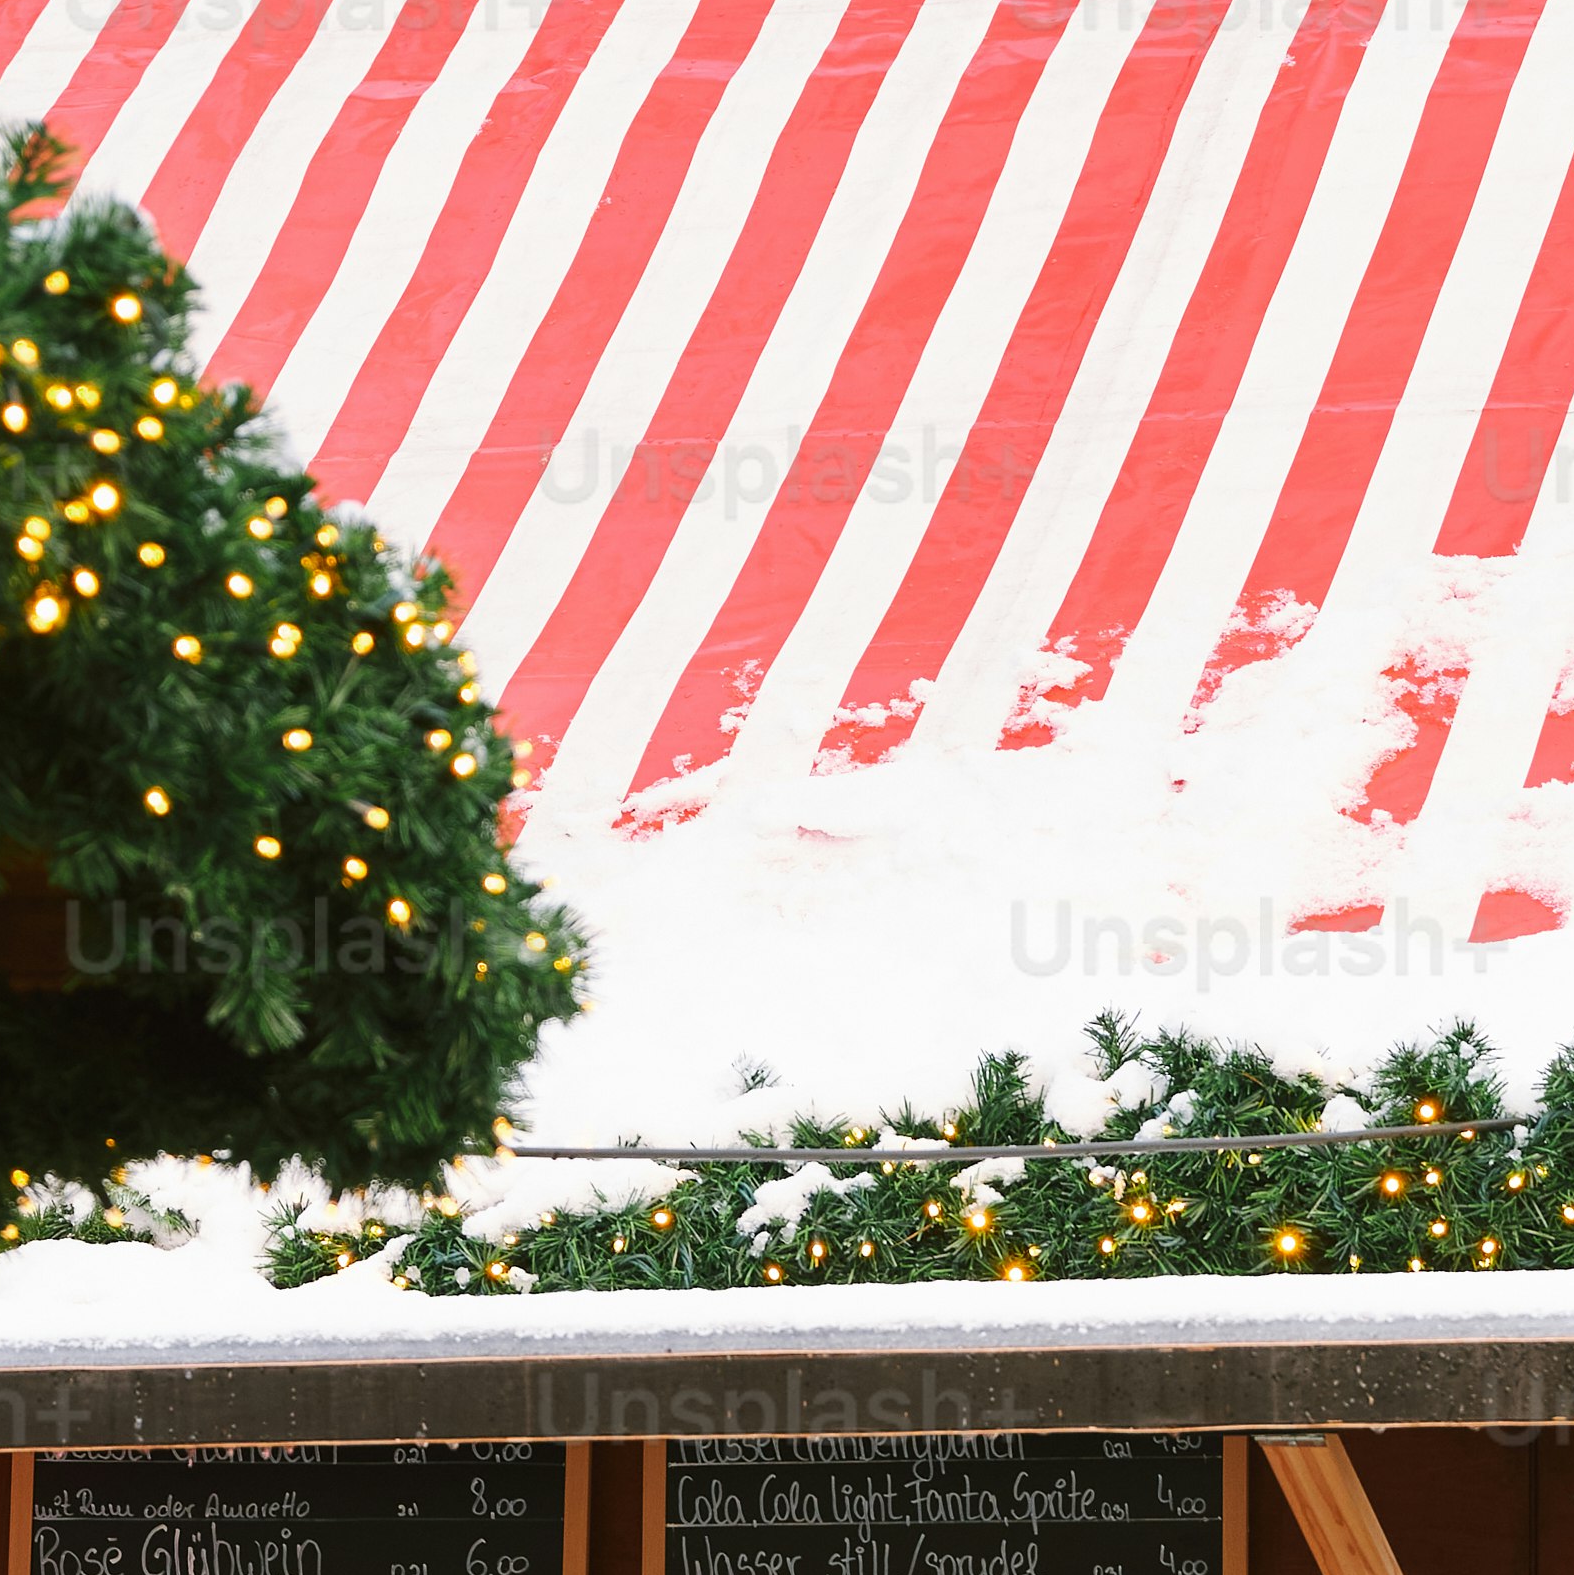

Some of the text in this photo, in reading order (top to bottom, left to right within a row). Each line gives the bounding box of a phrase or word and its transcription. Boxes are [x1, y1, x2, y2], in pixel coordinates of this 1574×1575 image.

[35, 1490, 73, 1520] mit
[144, 1494, 195, 1519] oder
[206, 1491, 310, 1518] Amaretto
[471, 1477, 527, 1520] 8,00
[1157, 1472, 1207, 1517] 4,00
